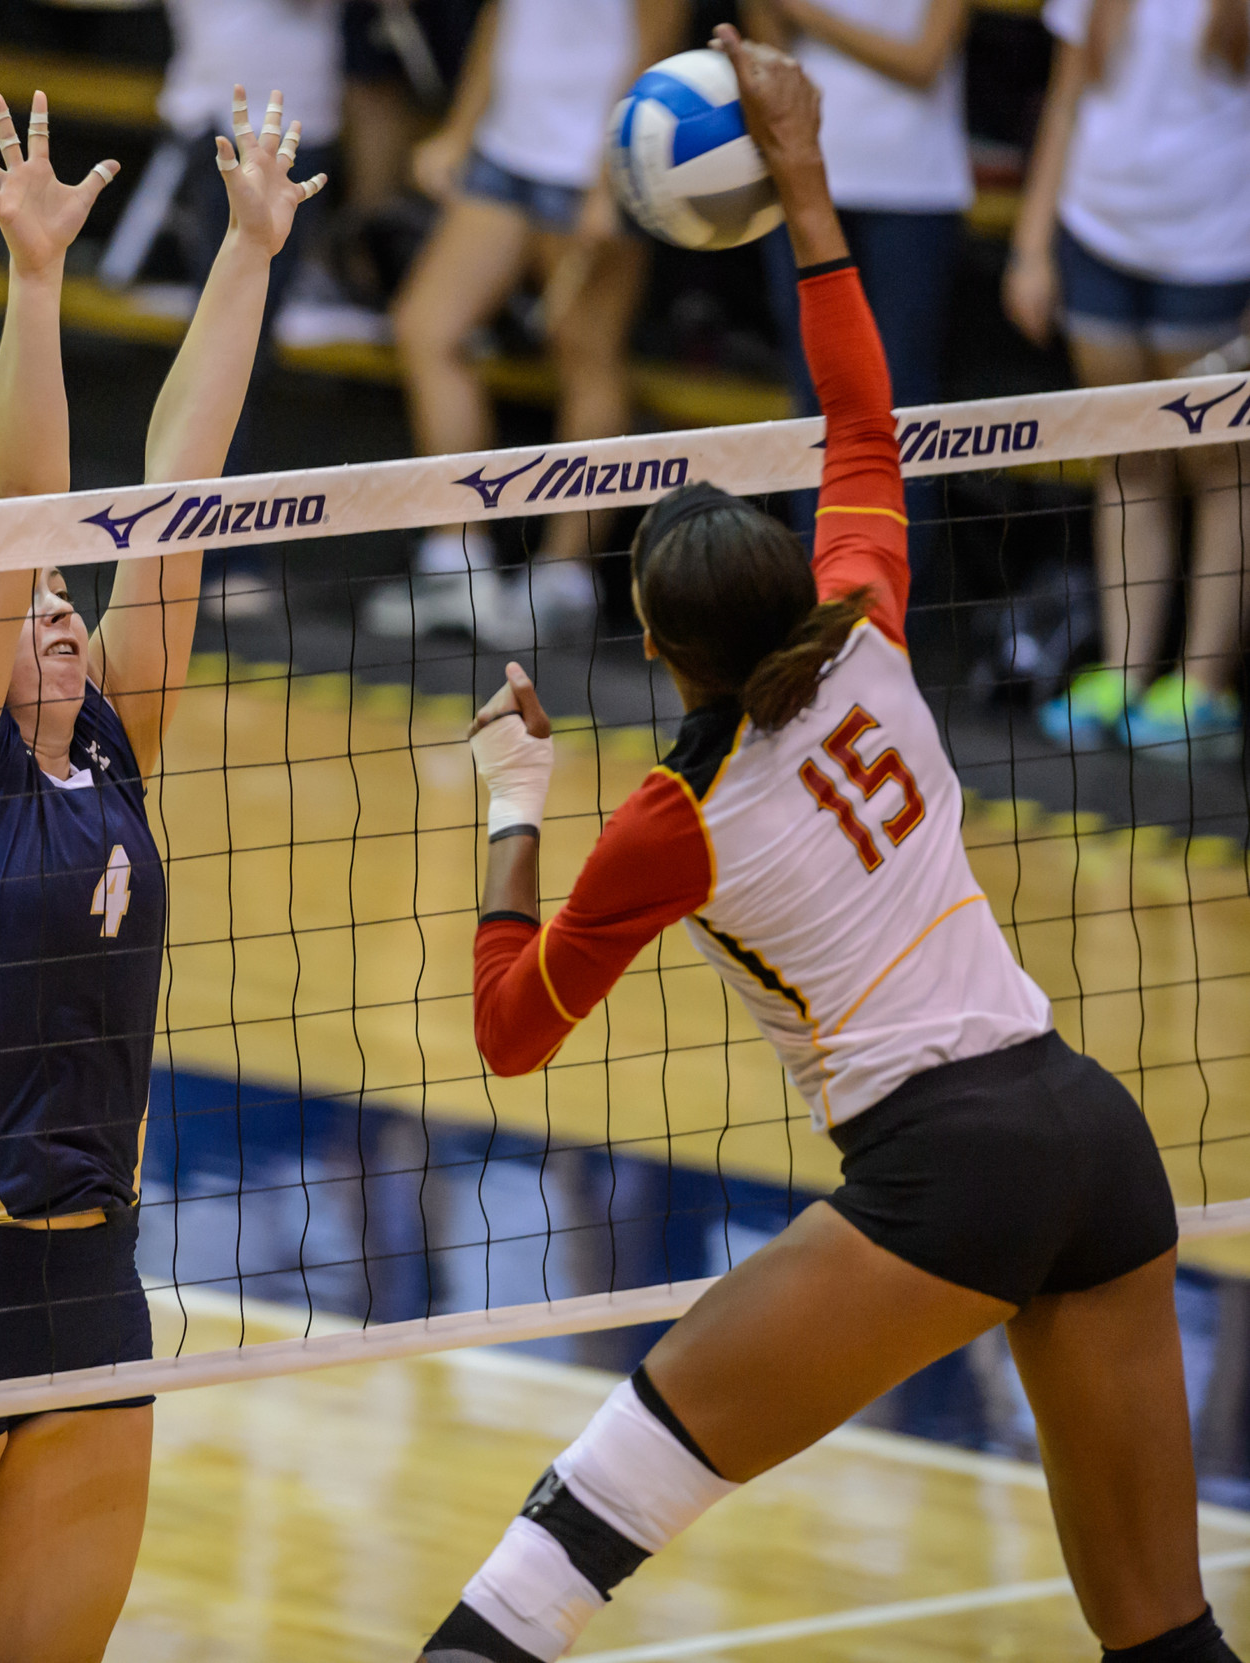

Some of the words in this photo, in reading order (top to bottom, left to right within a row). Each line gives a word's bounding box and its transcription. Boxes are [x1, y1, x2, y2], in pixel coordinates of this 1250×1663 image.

[525, 456, 688, 502] MIZUNO
[158, 495, 325, 542] MIZUNO
[798, 703, 926, 874] 15
[90, 844, 131, 937] 4
